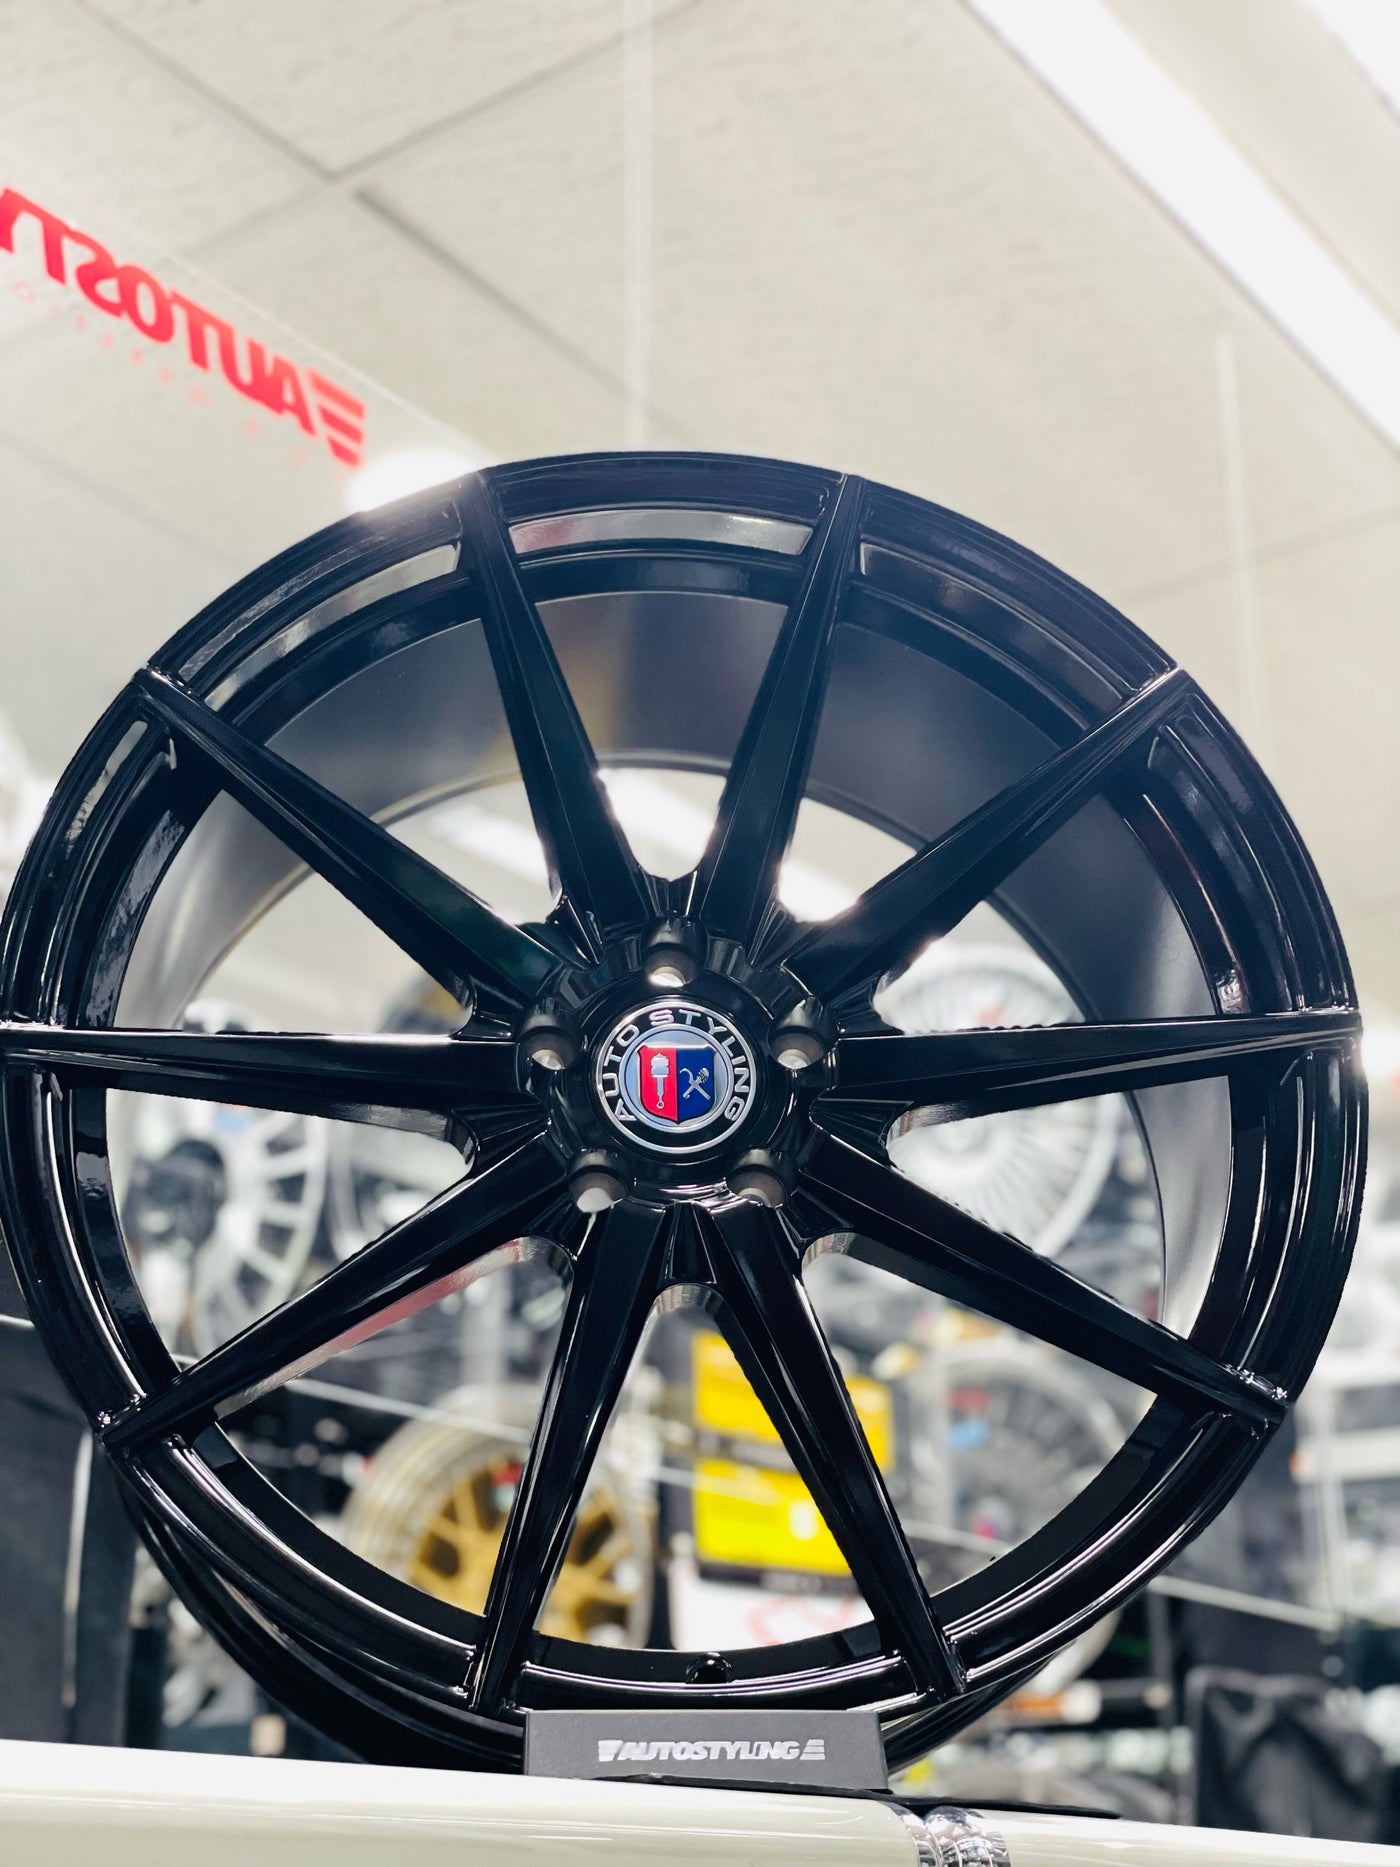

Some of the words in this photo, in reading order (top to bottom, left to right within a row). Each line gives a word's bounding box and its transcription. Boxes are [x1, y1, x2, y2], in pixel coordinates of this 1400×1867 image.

[603, 1024, 640, 1122] AUTO
[649, 1009, 750, 1122] STYLING
[618, 1740, 800, 1761] AUTOSTYLING
